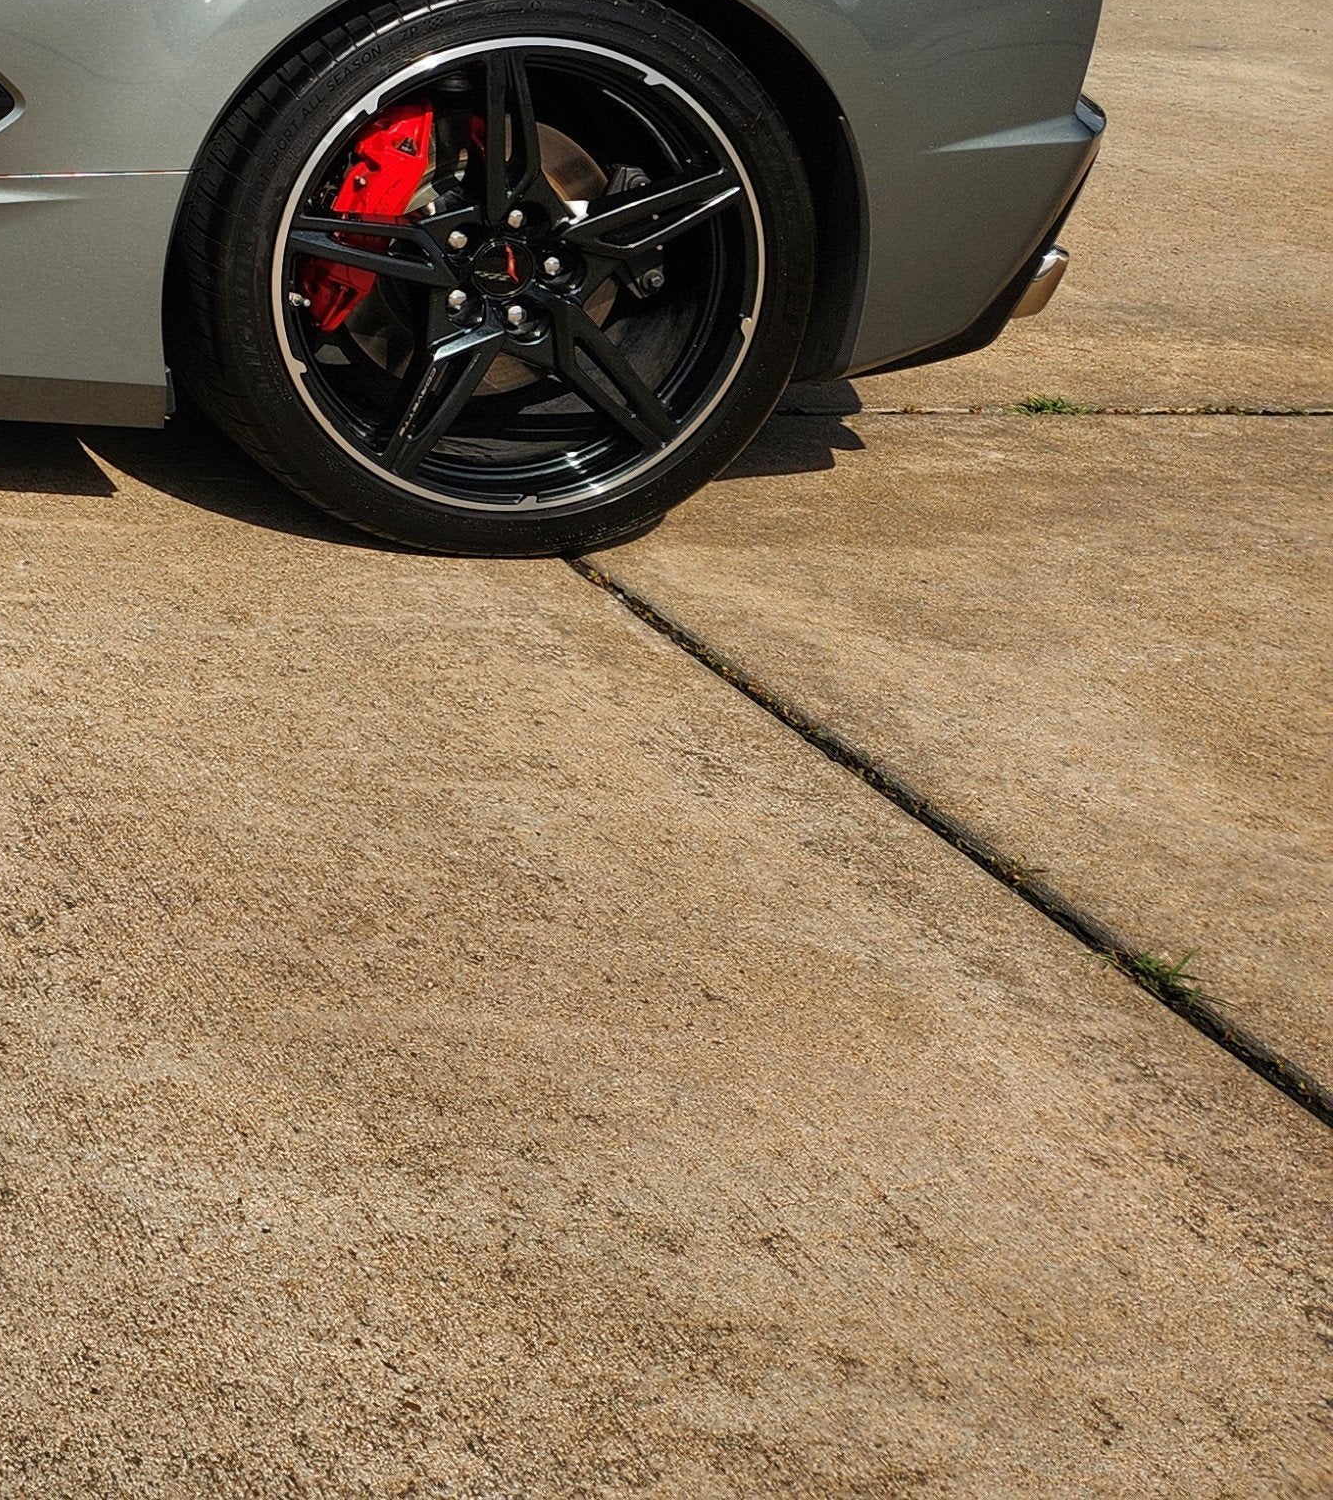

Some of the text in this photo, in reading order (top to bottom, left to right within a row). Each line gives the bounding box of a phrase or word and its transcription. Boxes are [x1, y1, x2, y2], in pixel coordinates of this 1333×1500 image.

[268, 120, 299, 167] SPORT
[302, 95, 325, 119] ALL
[326, 44, 382, 93] SEASON
